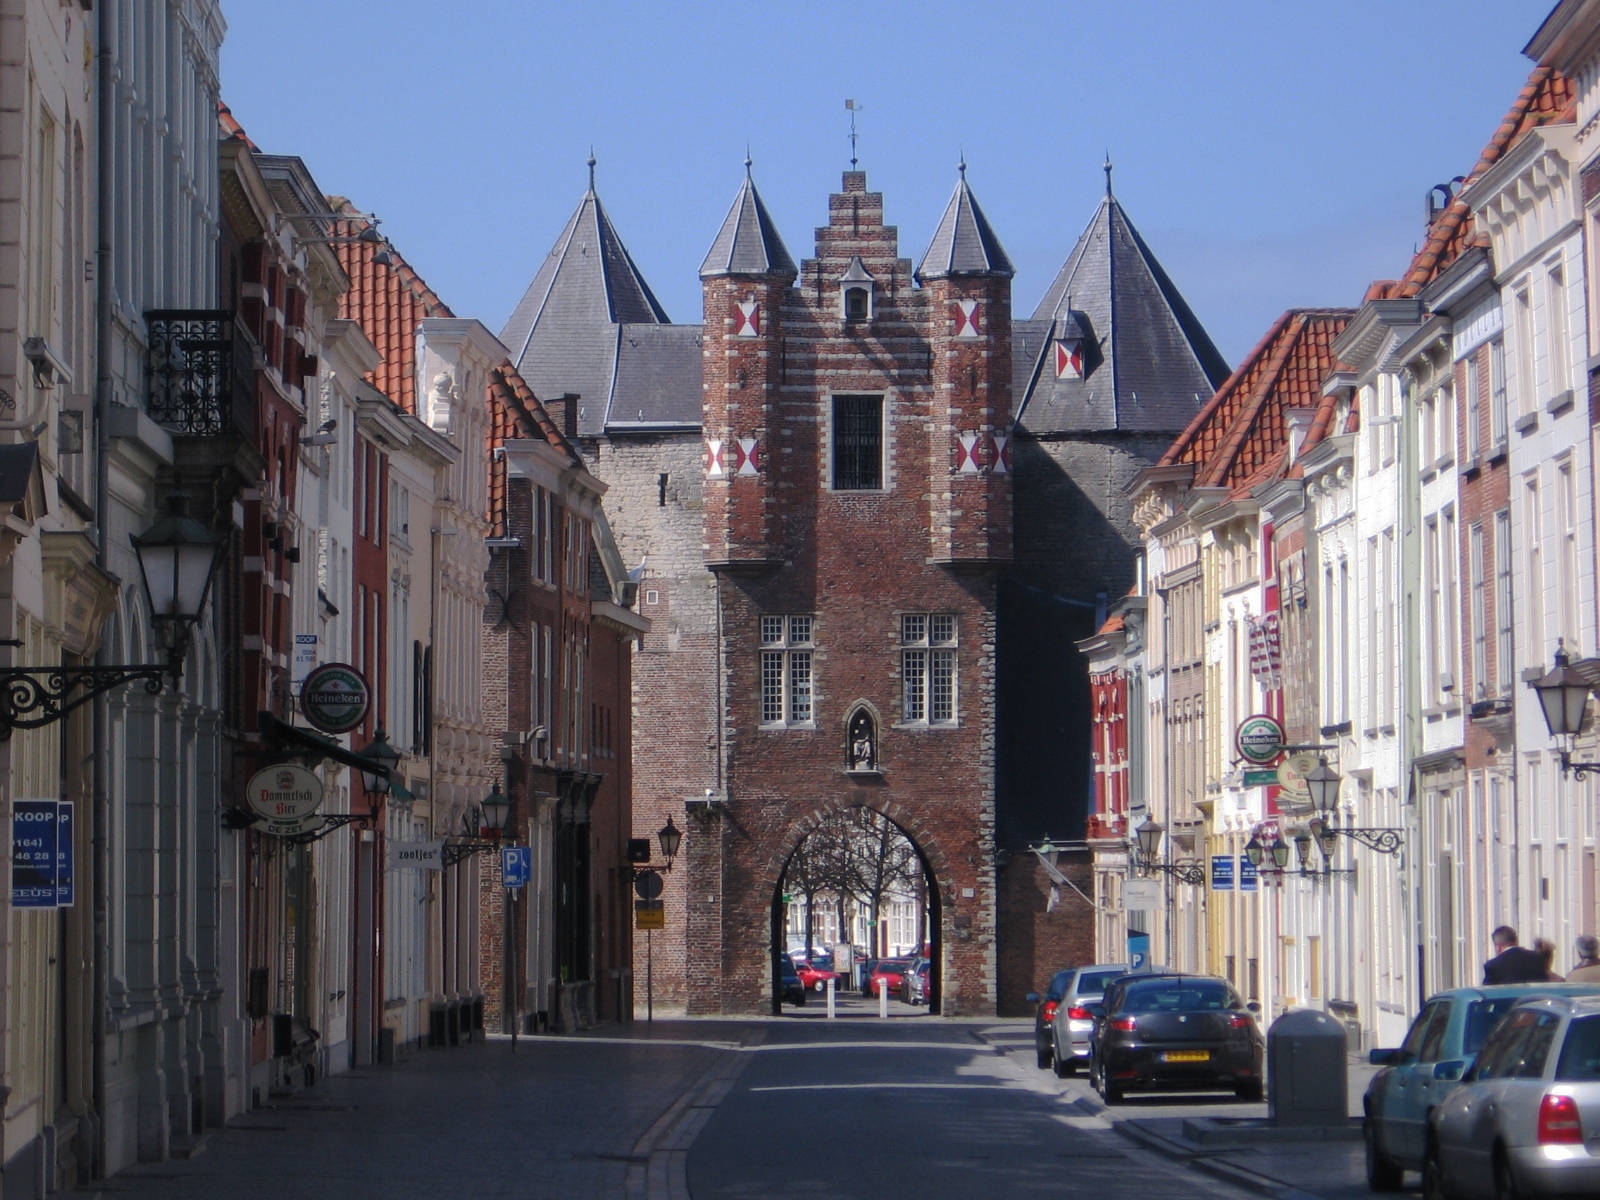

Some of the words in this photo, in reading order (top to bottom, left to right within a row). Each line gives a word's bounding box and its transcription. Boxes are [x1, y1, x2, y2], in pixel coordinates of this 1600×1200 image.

[311, 693, 361, 703] Heineken
[1243, 736, 1279, 744] Heineken
[260, 789, 312, 801] Dommelsch
[276, 802, 296, 815] Bier
[15, 812, 54, 822] KOOP
[268, 825, 282, 834] DE
[285, 825, 303, 834] ZET
[15, 852, 30, 860] 48
[34, 852, 49, 860] 28
[507, 852, 518, 871] P
[1133, 954, 1141, 967] P
